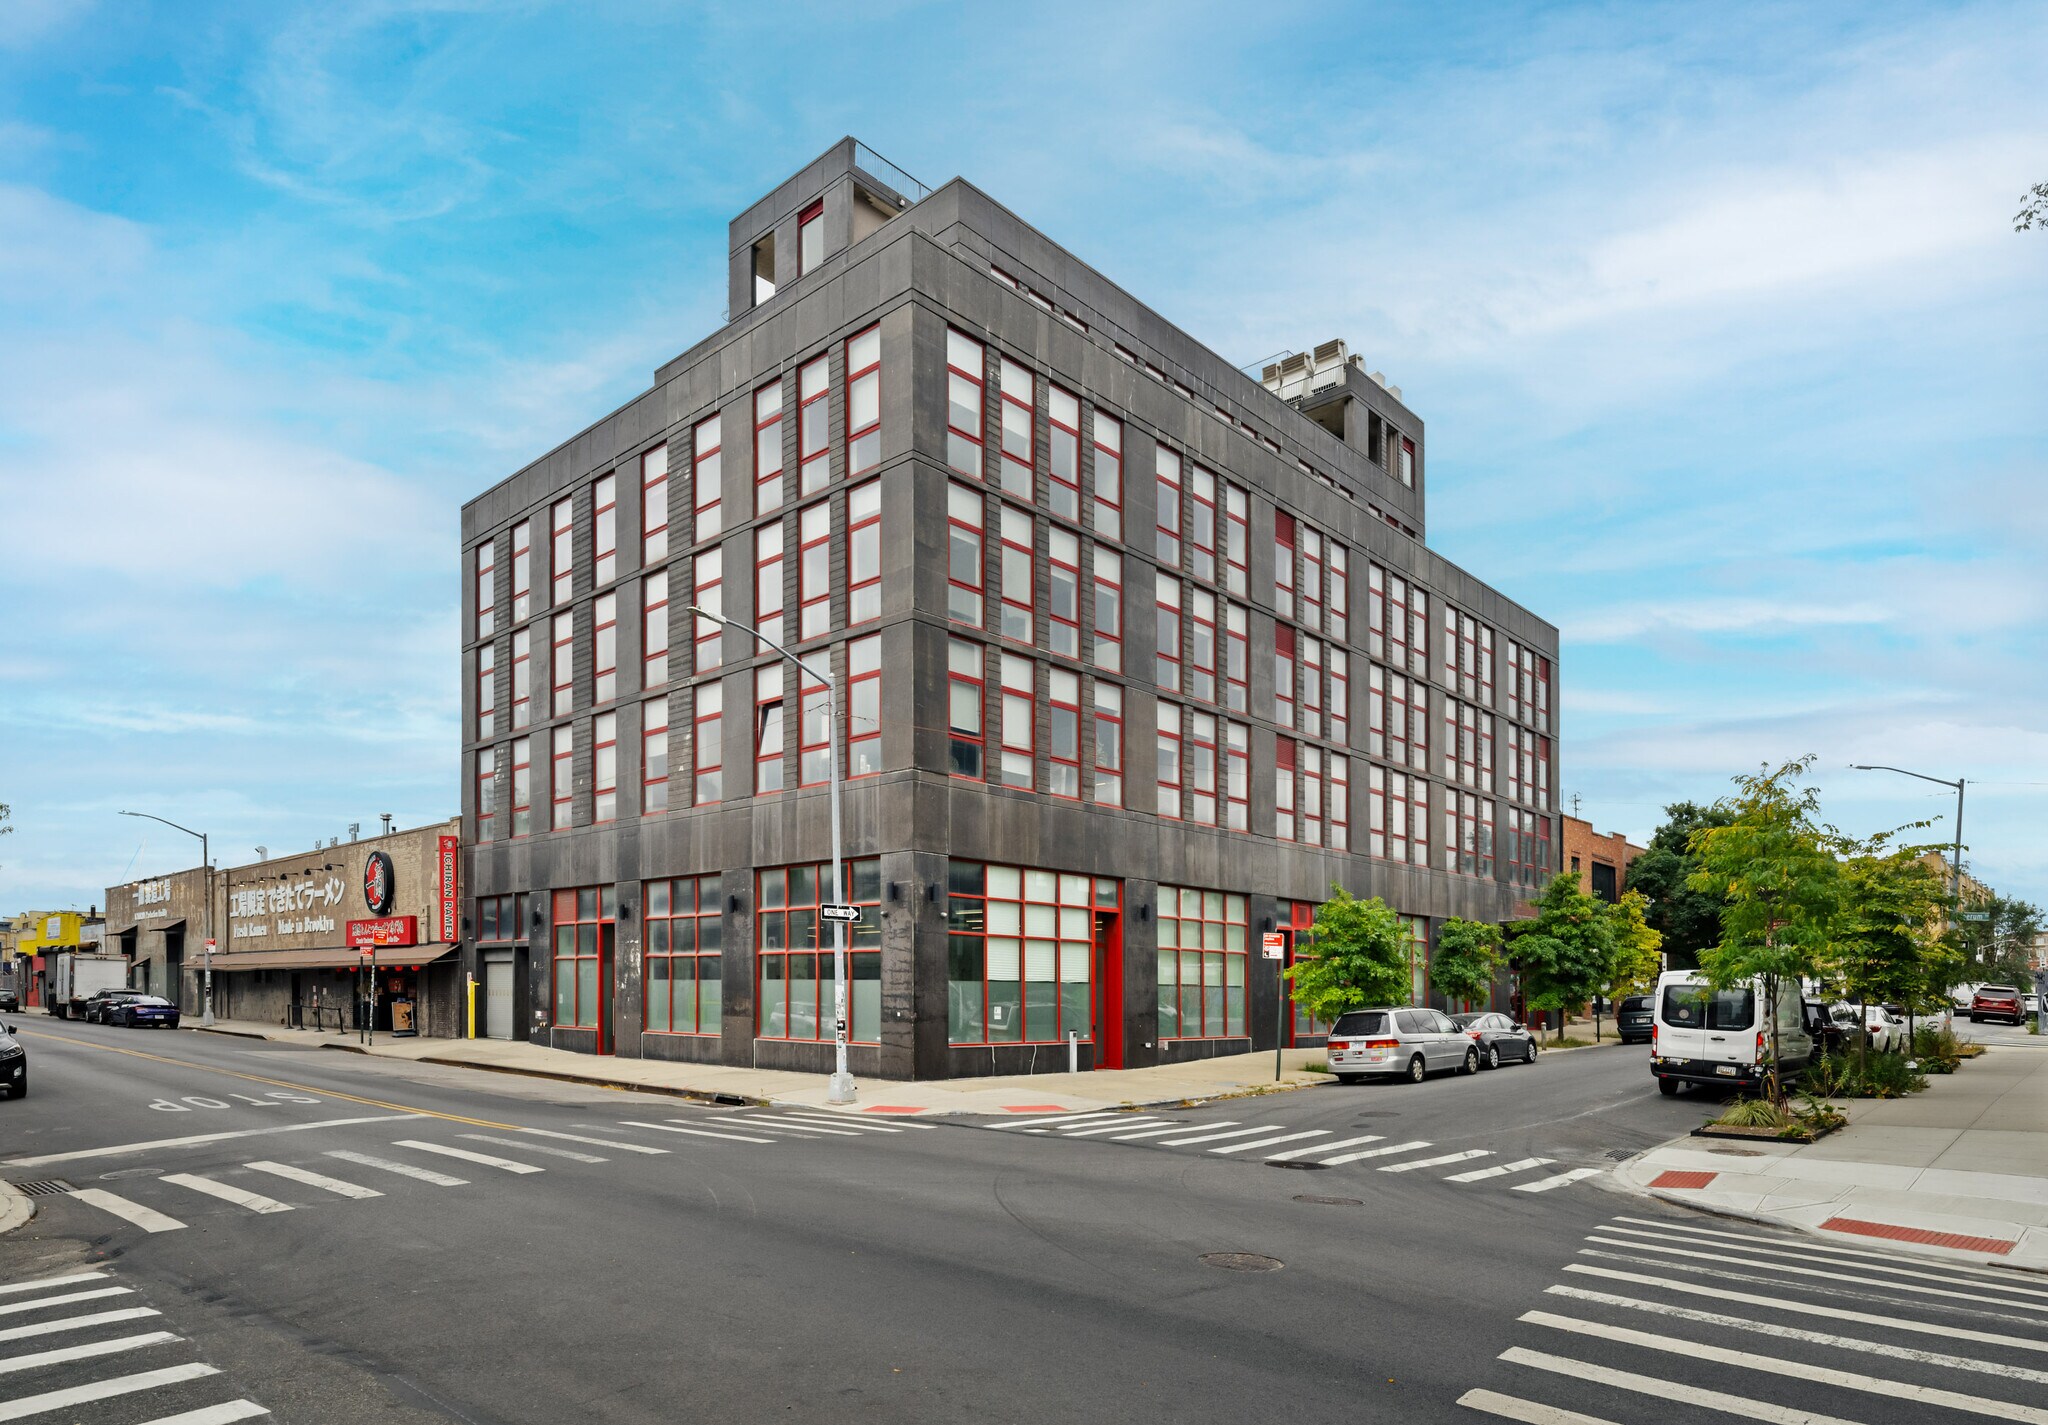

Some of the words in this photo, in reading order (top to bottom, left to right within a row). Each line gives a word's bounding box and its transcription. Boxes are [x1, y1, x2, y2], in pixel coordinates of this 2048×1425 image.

[444, 852, 453, 898] ICHIRAN
[278, 919, 294, 935] Made
[295, 917, 303, 934] in
[304, 915, 335, 935] Brooklyn
[444, 901, 453, 939] RAMEN
[148, 1092, 322, 1112] STOP
